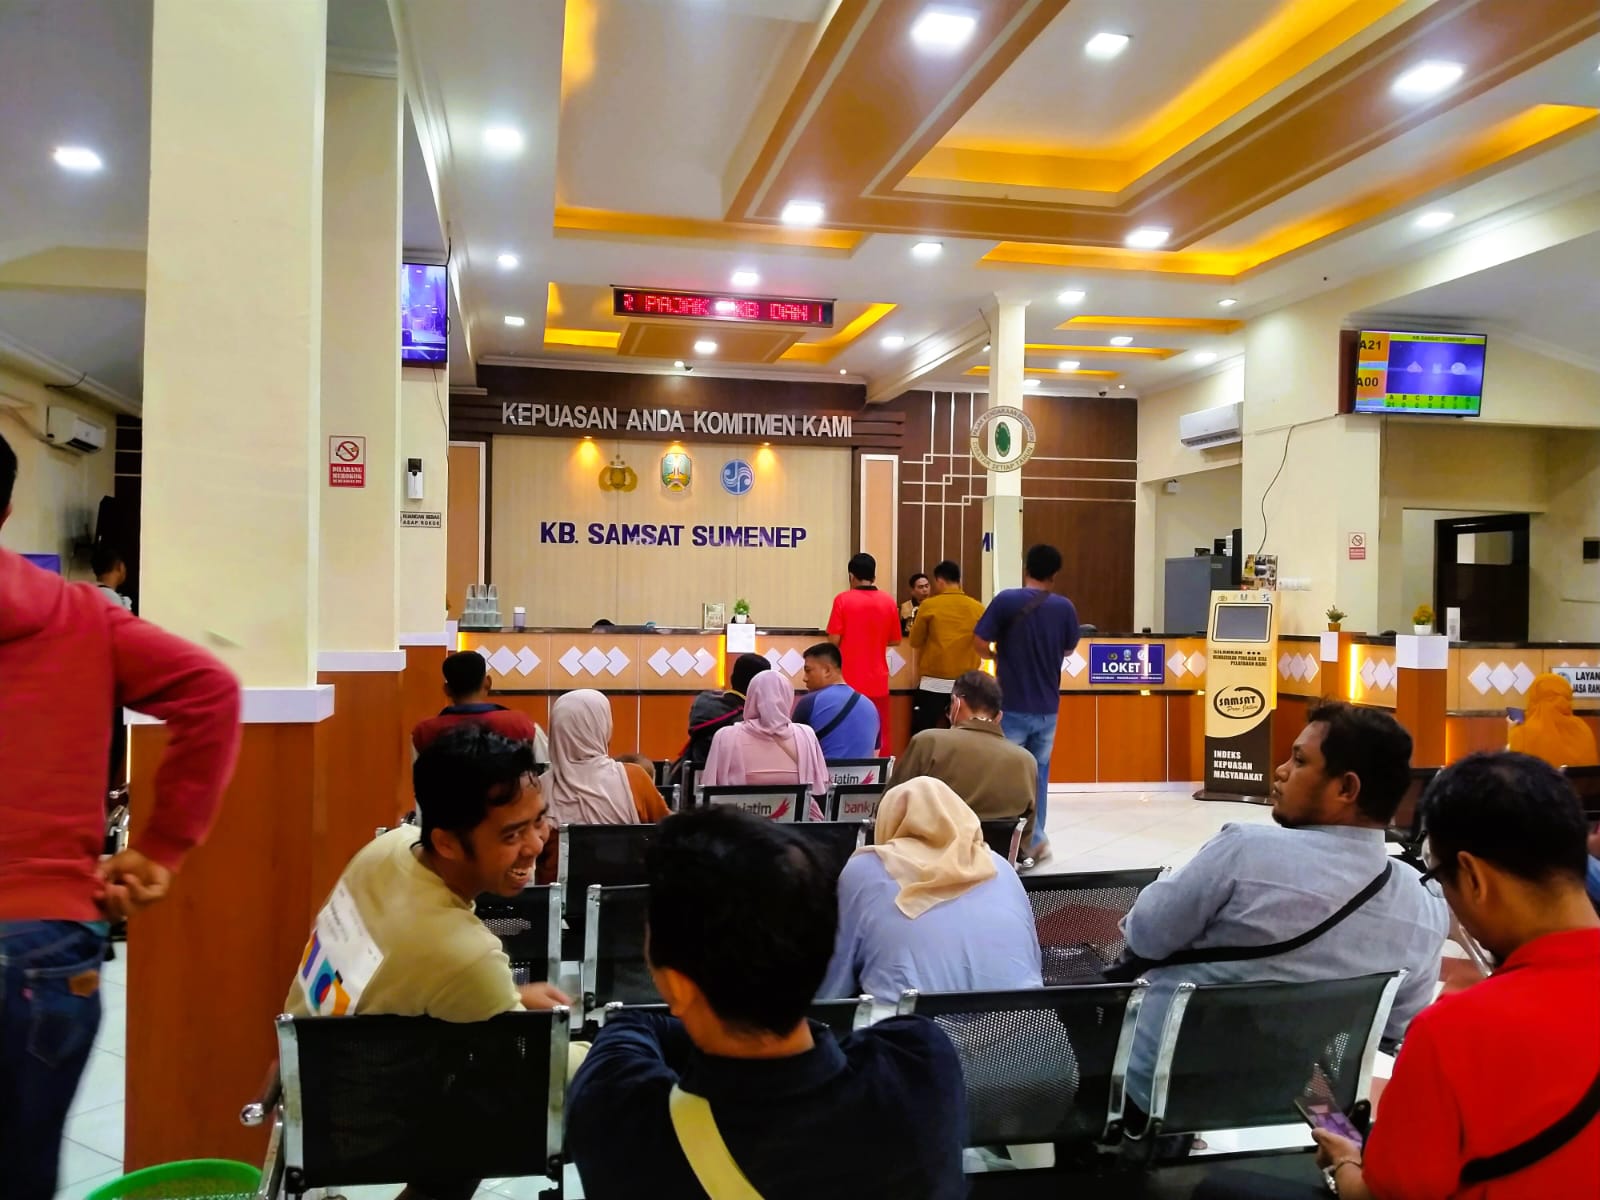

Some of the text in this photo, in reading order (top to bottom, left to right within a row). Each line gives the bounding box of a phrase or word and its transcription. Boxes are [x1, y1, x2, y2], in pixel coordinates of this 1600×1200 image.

[644, 295, 710, 315] PAJAK
[769, 303, 808, 321] DAN
[1360, 340, 1381, 350] A21
[1357, 377, 1378, 387] A00
[502, 402, 852, 437] KEPUASAN ANDA KOMITMEN KAMI
[540, 521, 807, 548] KB. SAMSAT SUMENEP
[1102, 662, 1141, 673] LOKET
[1219, 696, 1257, 706] SAMSAT
[1213, 750, 1241, 759] INDEKS
[1213, 760, 1253, 771] KEPUASAN
[1213, 770, 1264, 782] MASYARAKAT
